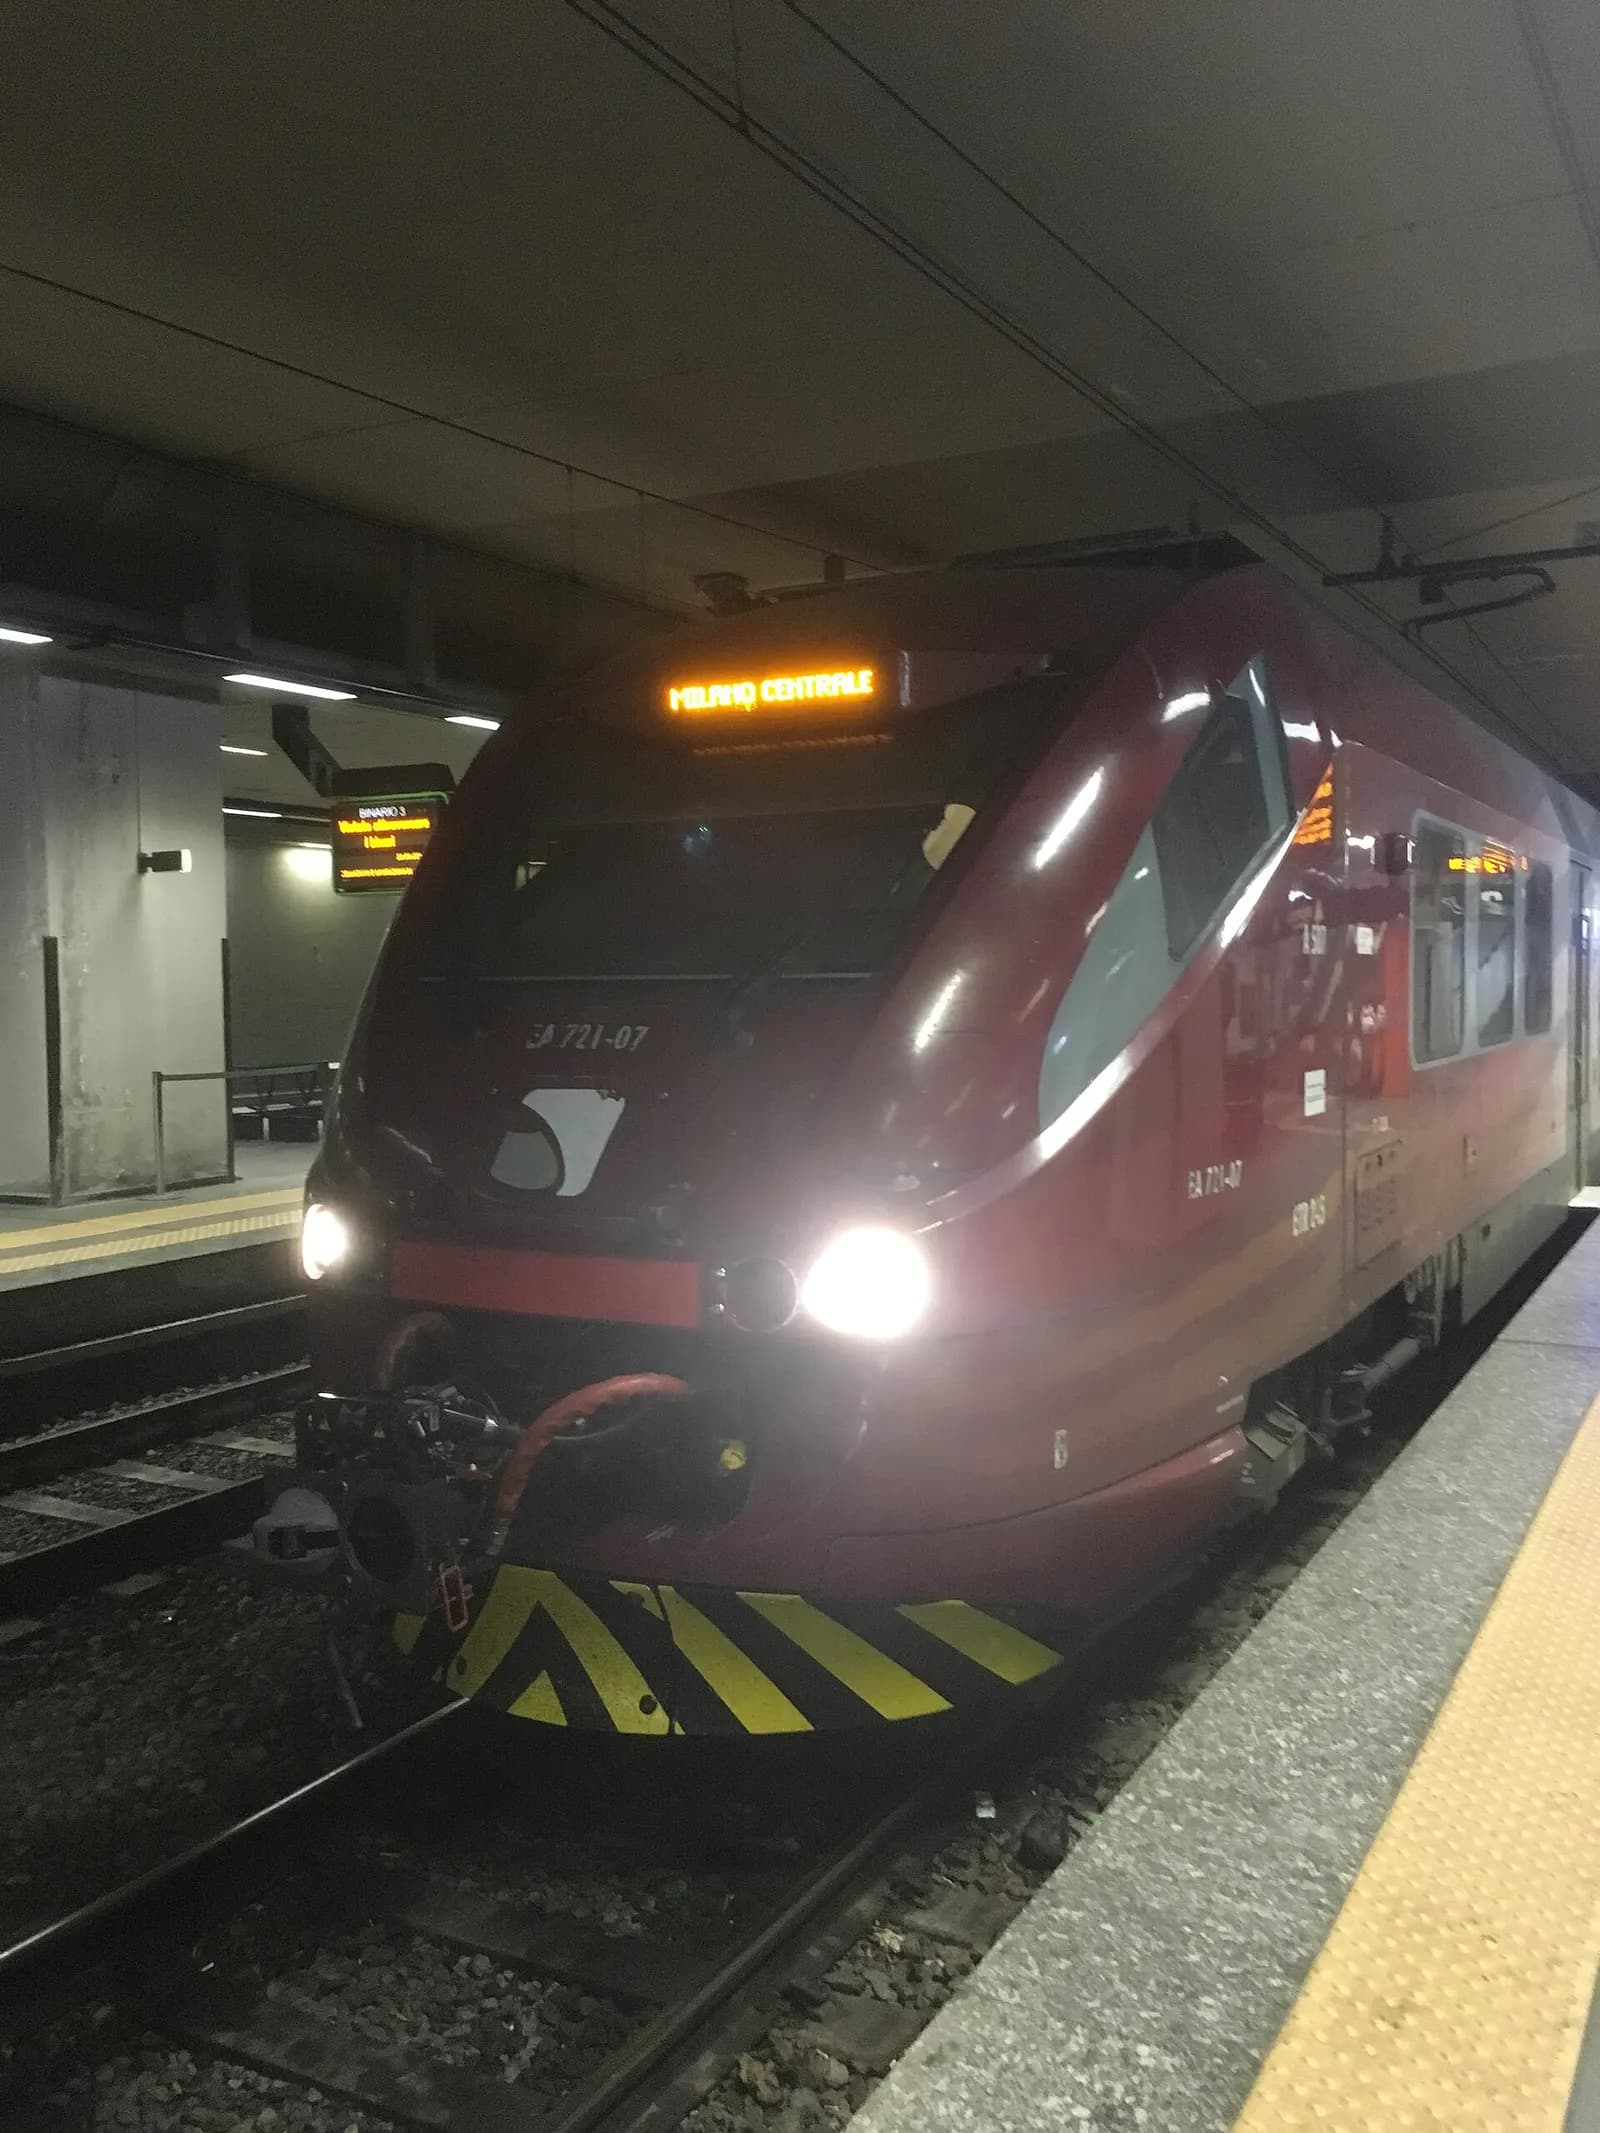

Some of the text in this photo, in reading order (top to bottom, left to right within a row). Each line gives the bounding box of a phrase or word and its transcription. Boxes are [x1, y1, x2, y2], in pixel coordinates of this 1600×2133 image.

[669, 670, 873, 710] MILANO CENTRALE
[359, 807, 398, 819] BINARIO
[559, 1023, 651, 1051] 721-07
